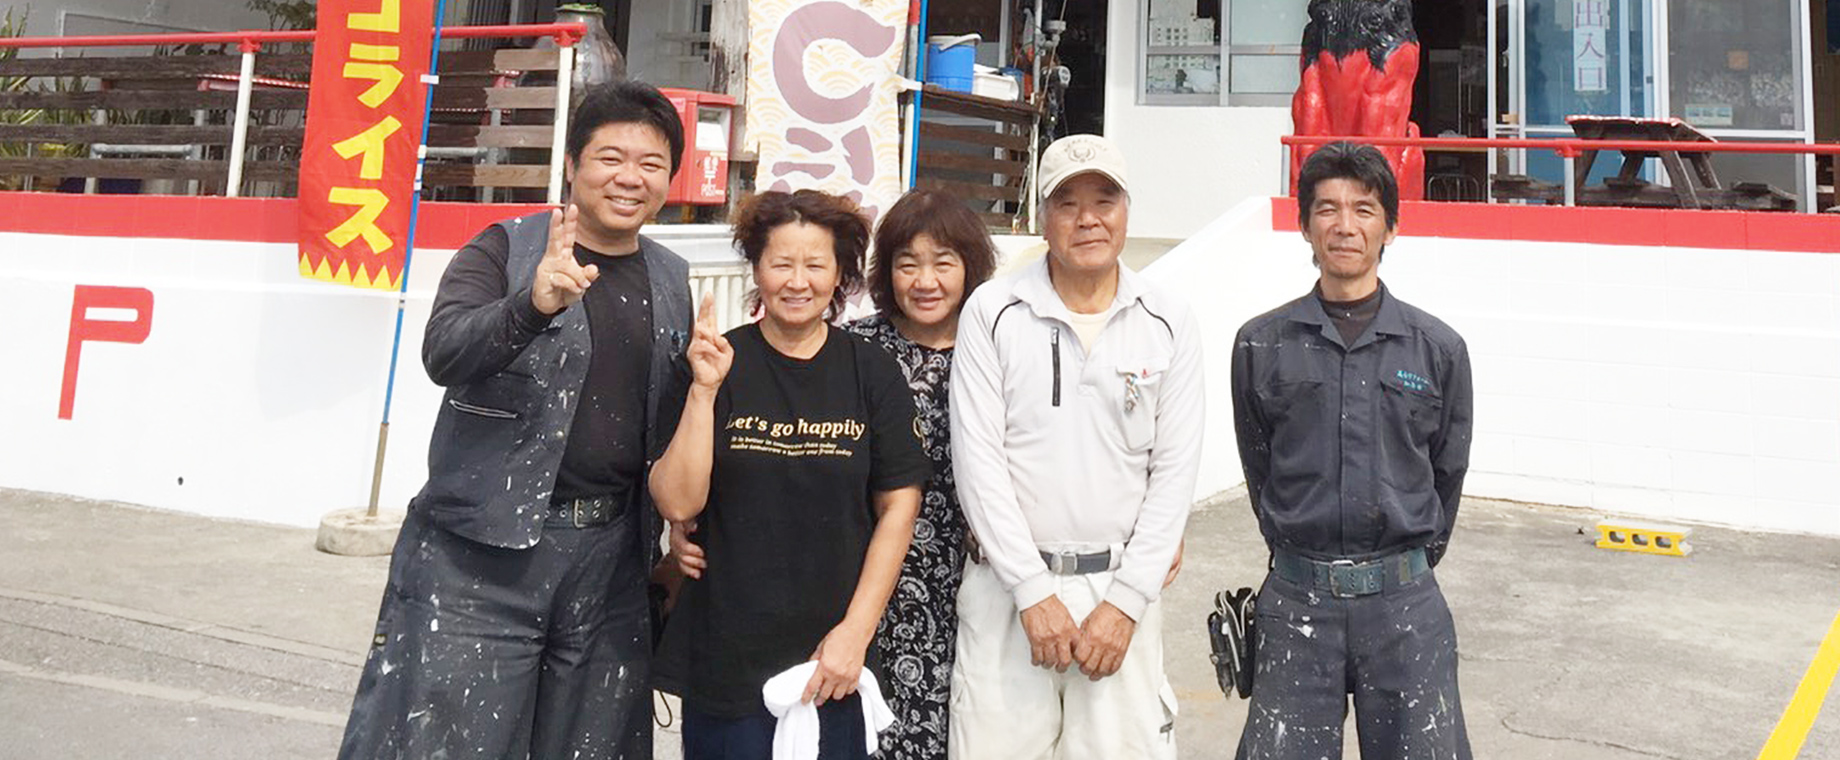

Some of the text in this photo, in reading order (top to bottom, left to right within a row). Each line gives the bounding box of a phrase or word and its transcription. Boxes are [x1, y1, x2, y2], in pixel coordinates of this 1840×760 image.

[1575, 0, 1604, 89] 出入口
[58, 284, 154, 420] P
[770, 422, 794, 437] go
[797, 418, 865, 440] happily
